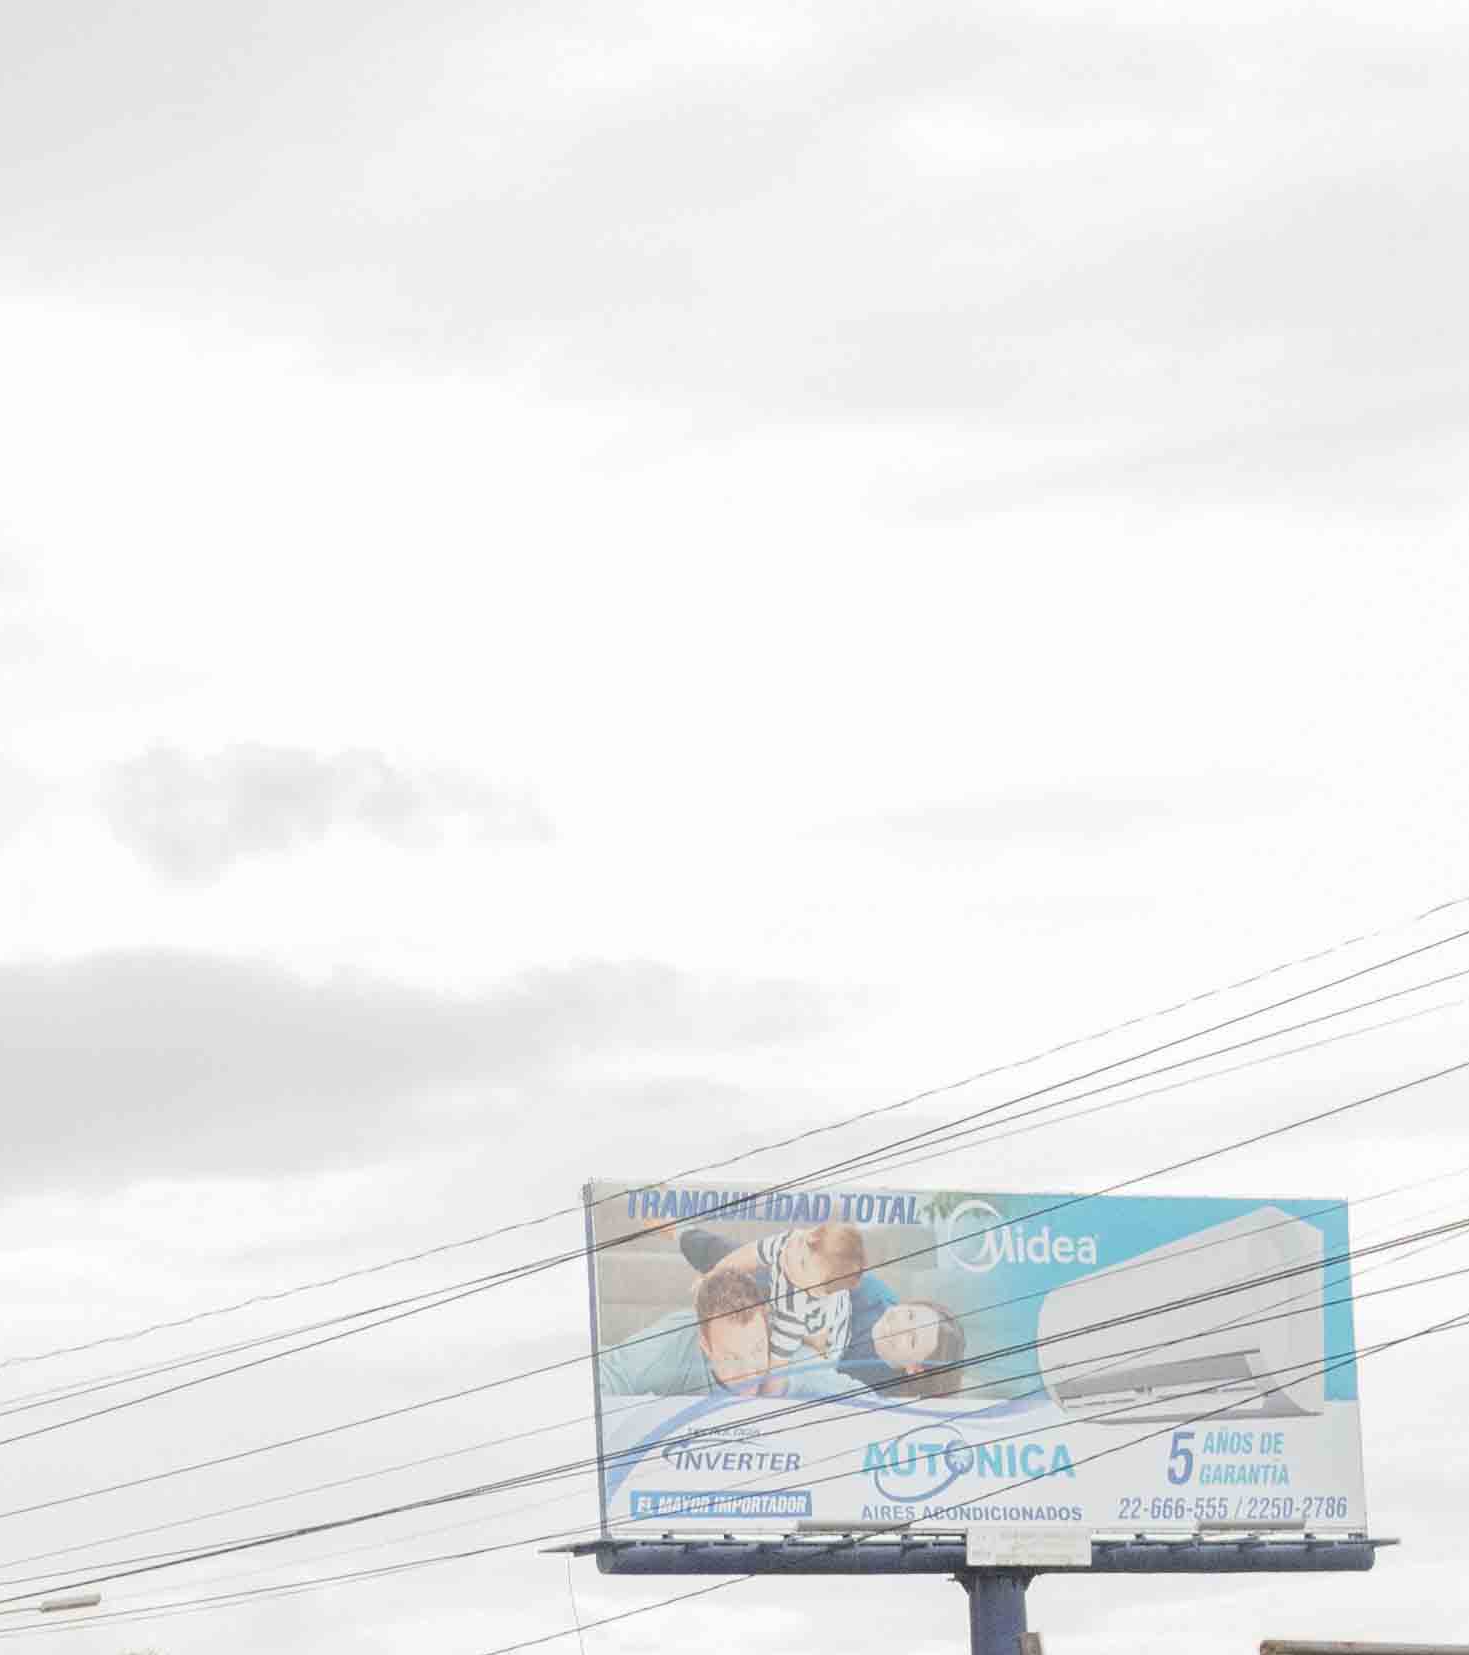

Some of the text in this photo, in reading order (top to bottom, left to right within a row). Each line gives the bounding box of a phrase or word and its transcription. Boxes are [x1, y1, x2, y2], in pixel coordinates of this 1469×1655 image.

[627, 1190, 921, 1225] TRANQUILIDAD TOTAL
[1166, 1428, 1285, 1486] 5 AÑOS DE
[658, 1495, 709, 1513] MAYOR
[713, 1494, 807, 1513] IMPORTADOR
[860, 1505, 1083, 1522] AIRES ACONDICIONADOS
[1118, 1496, 1228, 1520] 22-666-555
[1246, 1496, 1348, 1519] 2250-2786
